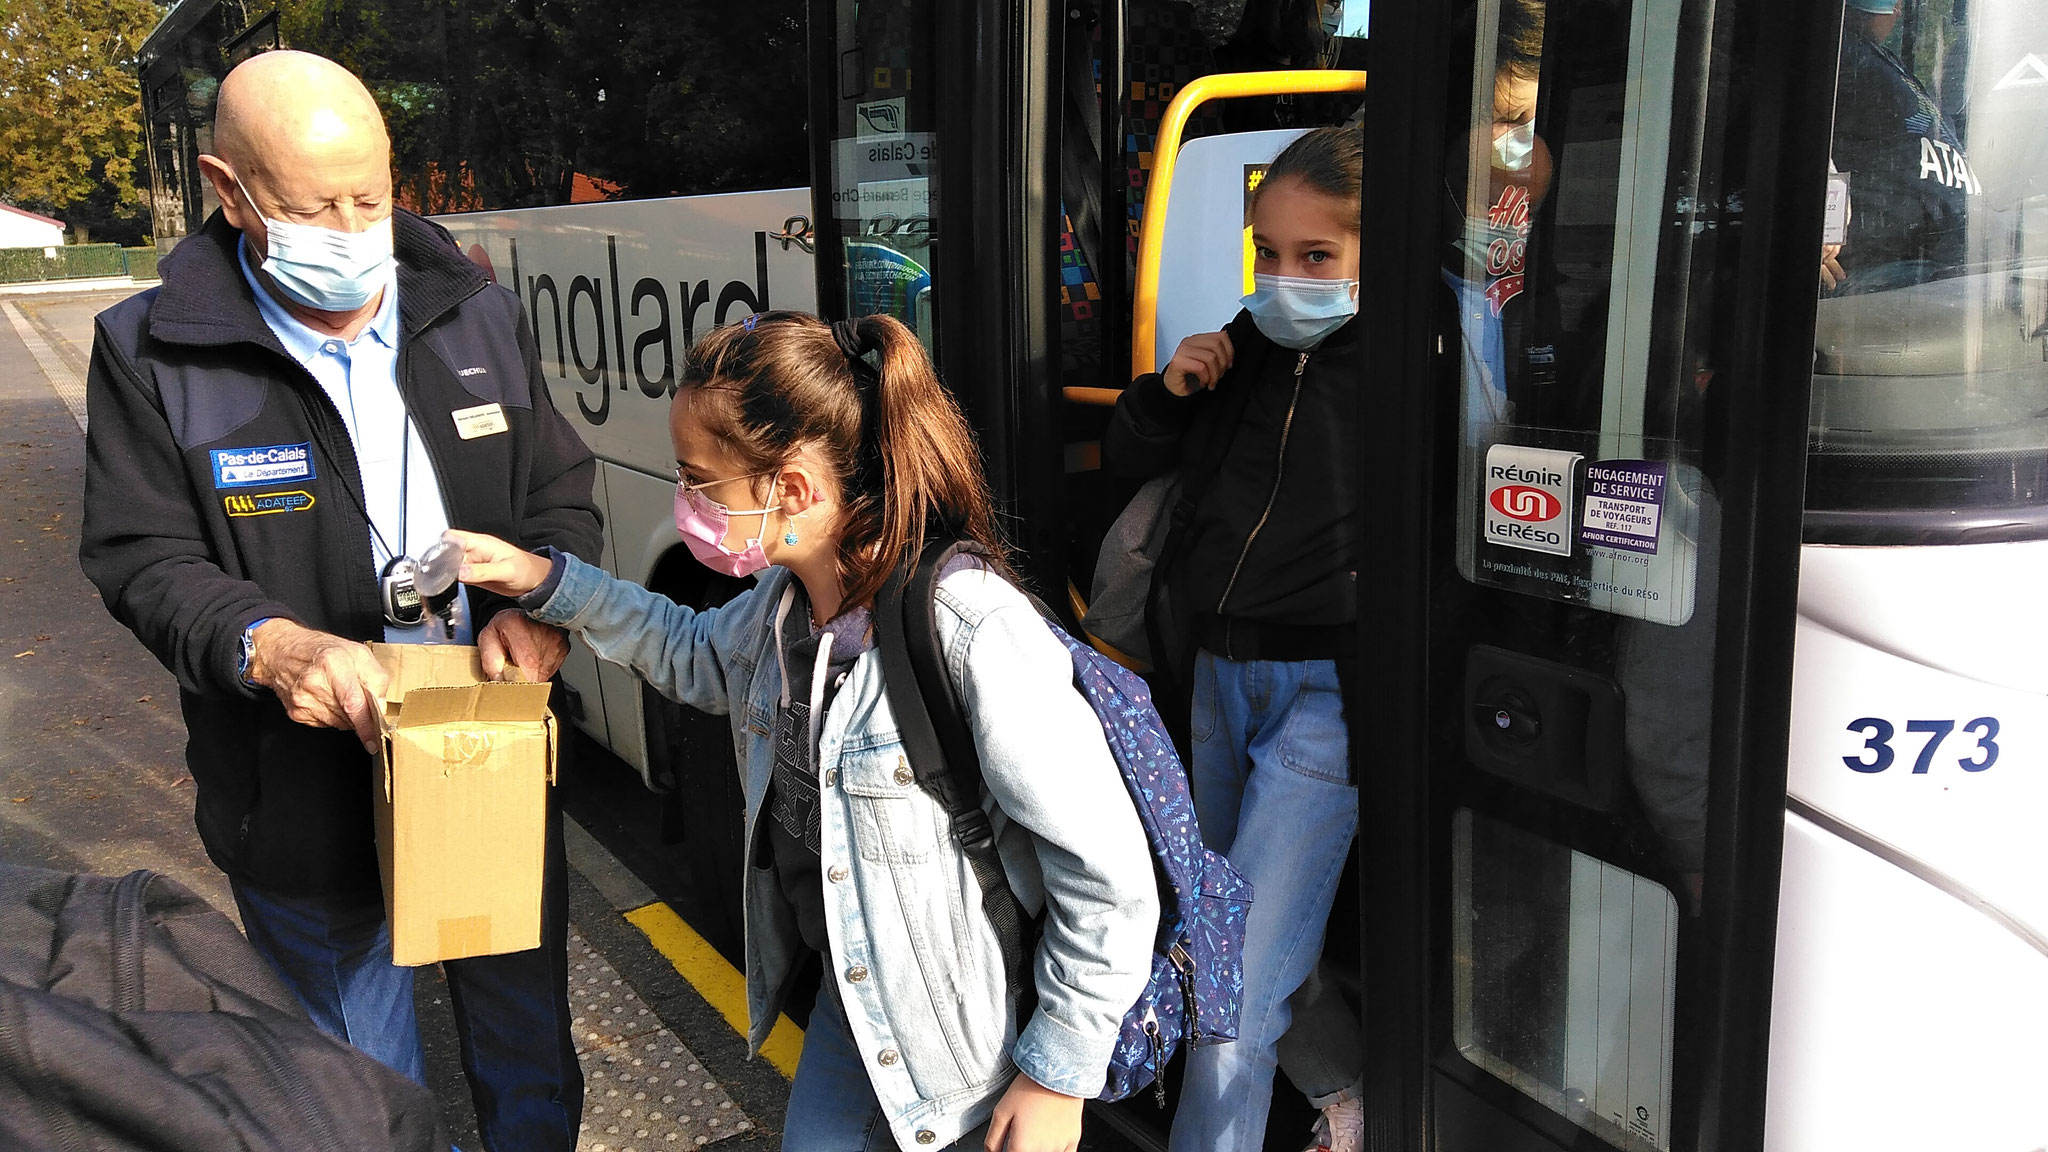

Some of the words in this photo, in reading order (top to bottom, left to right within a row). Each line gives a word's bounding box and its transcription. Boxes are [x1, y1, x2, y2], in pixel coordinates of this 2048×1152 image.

[218, 447, 307, 466] Pas-de-Calais
[244, 470, 254, 478] Le
[256, 464, 305, 476] Département
[1588, 467, 1664, 487] ENGAGEMENT
[1593, 482, 1607, 494] DE
[1610, 484, 1655, 500] SERVICE
[256, 495, 307, 510] ADATEEP
[1598, 500, 1646, 515] TRANSPORT
[1590, 509, 1601, 518] DE
[1603, 511, 1652, 526] VOYAGEURS
[1621, 524, 1632, 532] 117
[1582, 531, 1605, 541] AFNOR
[1605, 535, 1656, 550] CERTIFICATION
[1585, 548, 1649, 567] www.afnor.org
[1482, 559, 1492, 569] La
[1493, 563, 1532, 577] proximité
[1534, 568, 1549, 580] des
[1621, 585, 1633, 597] du
[1842, 716, 2000, 775] 373
